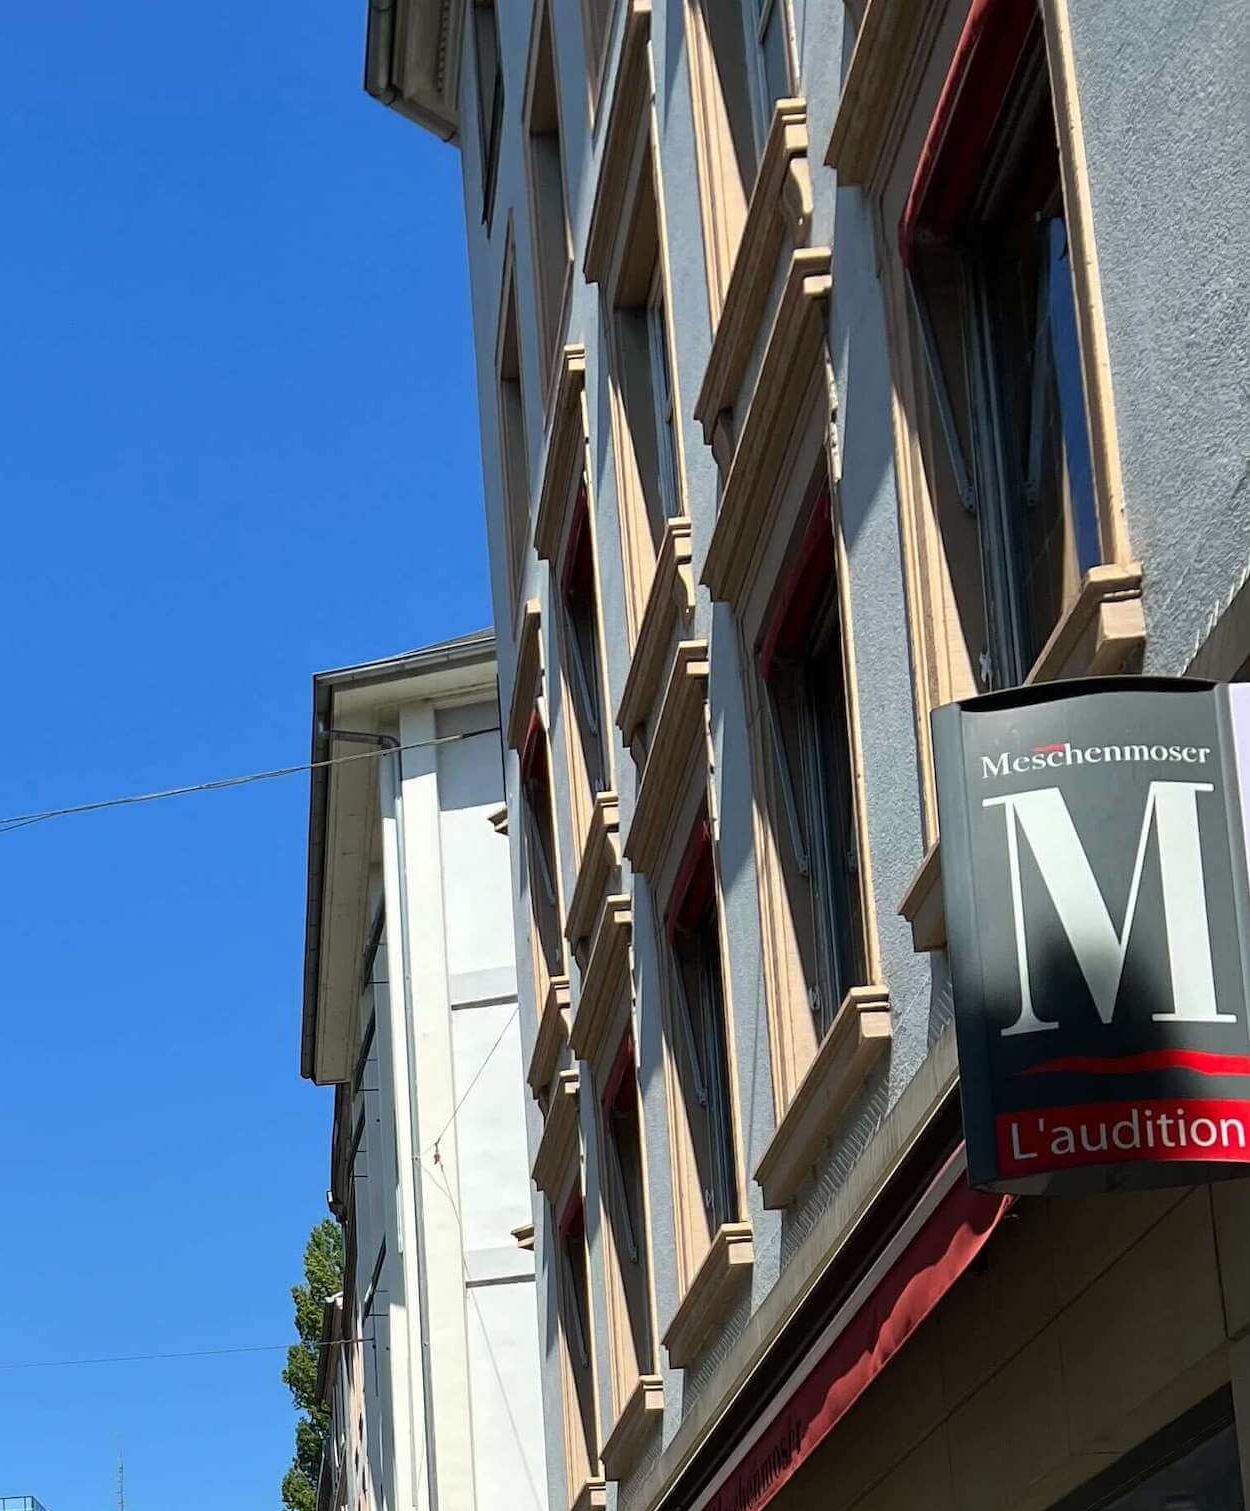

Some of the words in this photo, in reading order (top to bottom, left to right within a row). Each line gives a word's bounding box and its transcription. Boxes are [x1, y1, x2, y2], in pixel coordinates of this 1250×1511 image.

[982, 742, 1210, 779] Meschenmoser
[982, 781, 1237, 1037] M
[1011, 1108, 1246, 1161] L'audition
